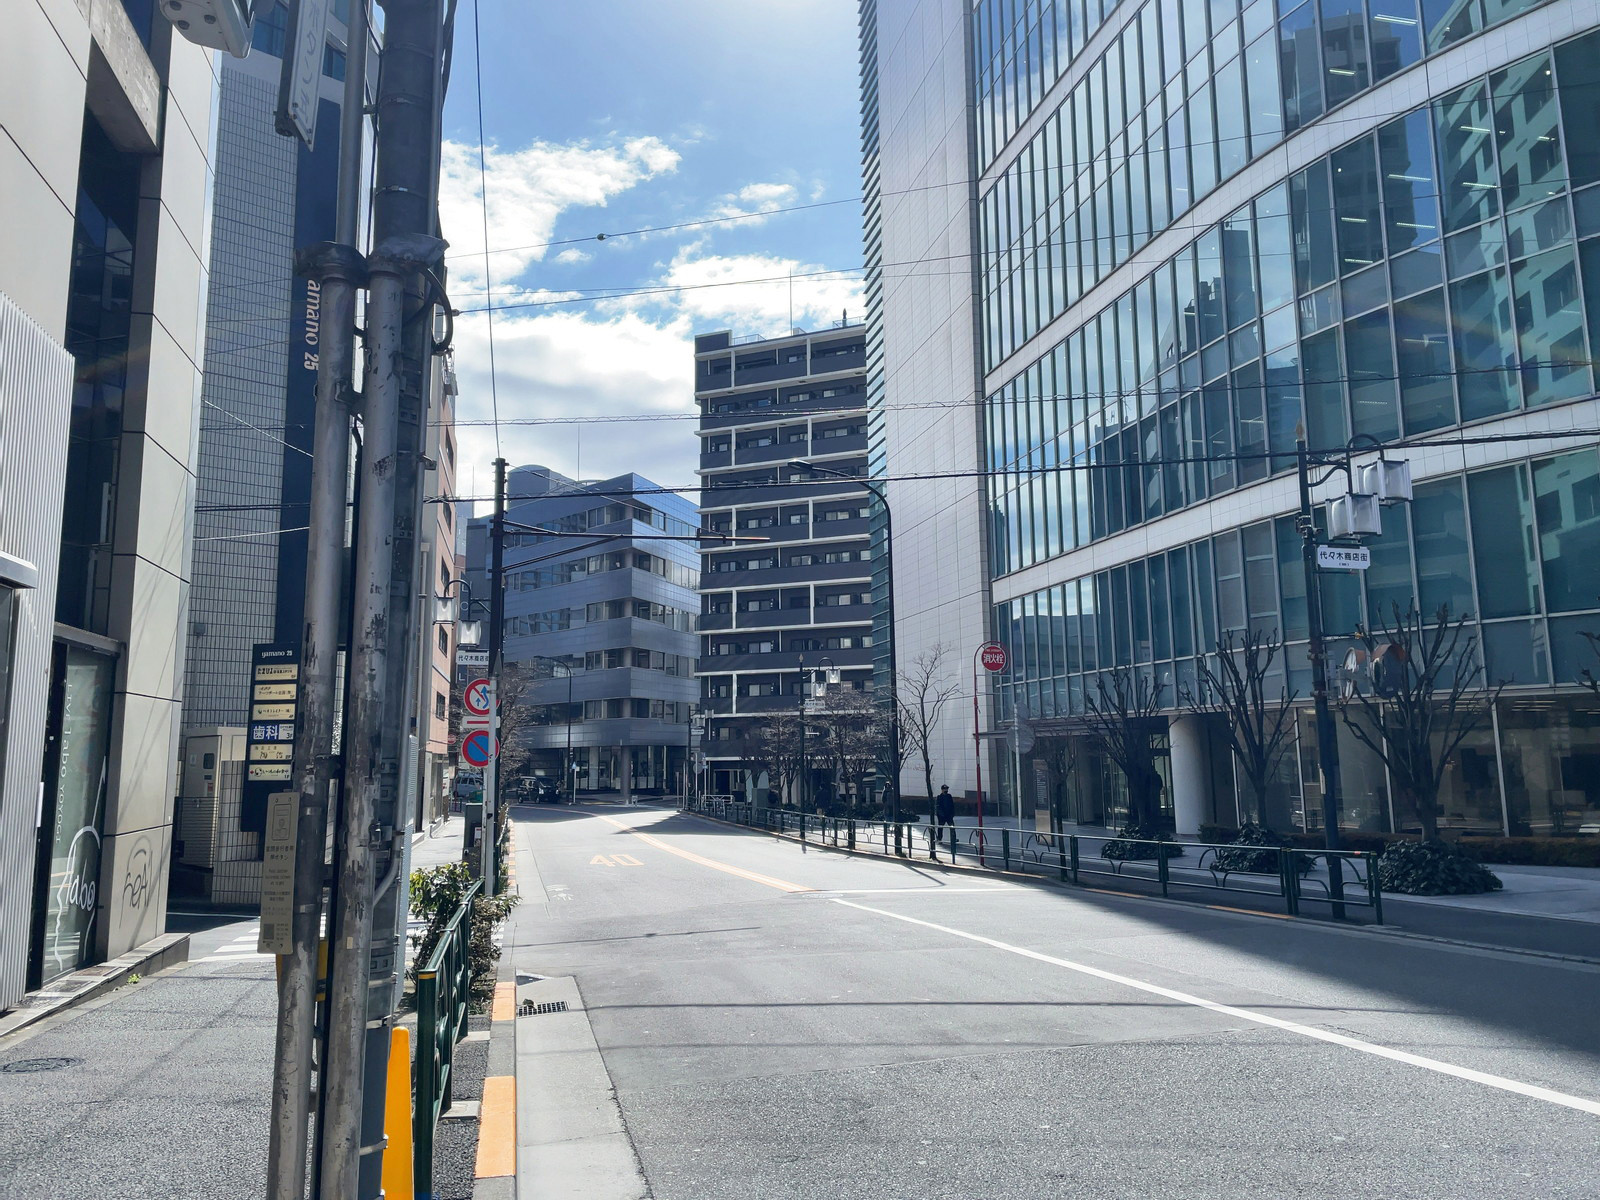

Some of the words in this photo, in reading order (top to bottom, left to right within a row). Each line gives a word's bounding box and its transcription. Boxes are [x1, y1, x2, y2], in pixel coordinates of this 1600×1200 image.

[305, 280, 320, 346] amano
[304, 351, 319, 371] 25
[1319, 550, 1368, 562] 代々木商店街
[261, 650, 285, 658] yamano
[983, 653, 1004, 664] 消火栓
[253, 724, 279, 740] 歯科
[56, 784, 65, 844] YOYOGI
[589, 854, 645, 867] 40
